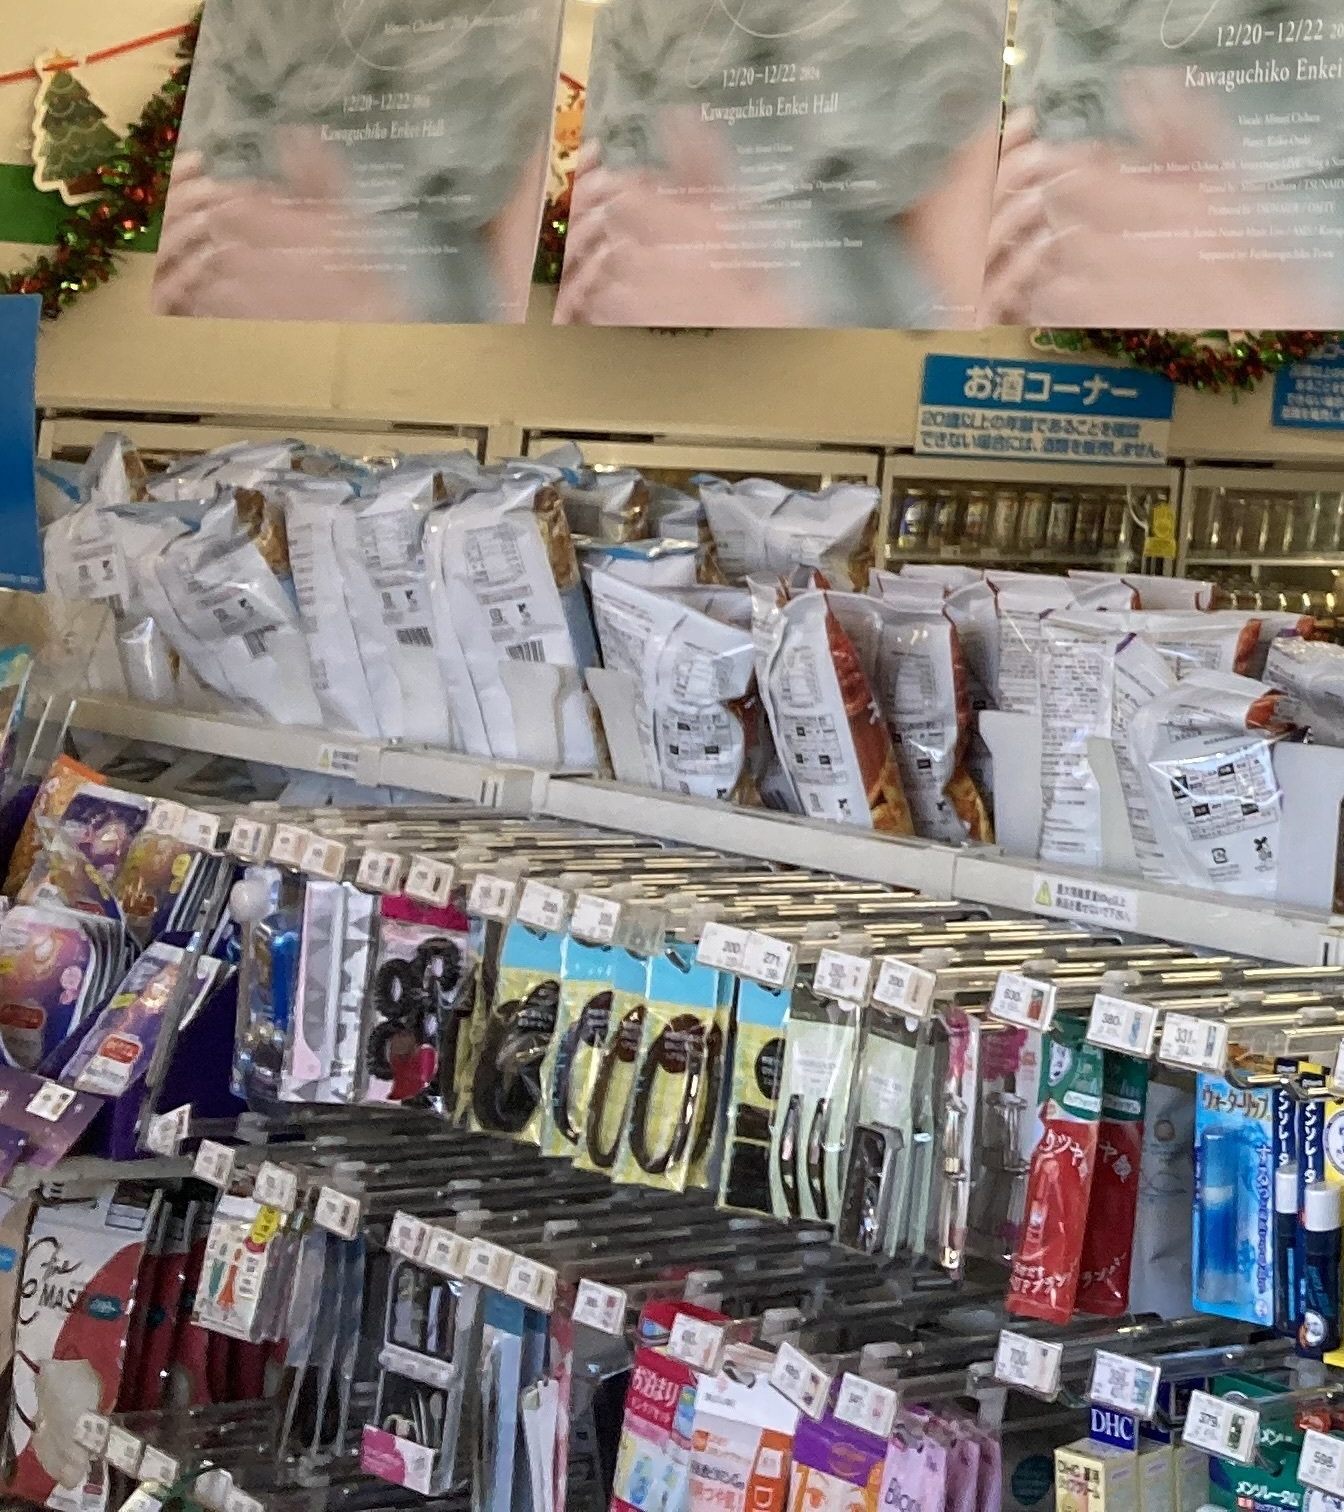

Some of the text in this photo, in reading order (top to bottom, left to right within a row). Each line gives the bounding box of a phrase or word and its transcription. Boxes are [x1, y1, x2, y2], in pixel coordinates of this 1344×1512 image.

[1185, 58, 1290, 92] Kawaguchiko
[1296, 56, 1343, 81] Enkei
[701, 93, 839, 126] Kawaguchiko Enkei Hall
[964, 365, 1138, 406] お酒コーナー
[1090, 1409, 1135, 1441] DHC
